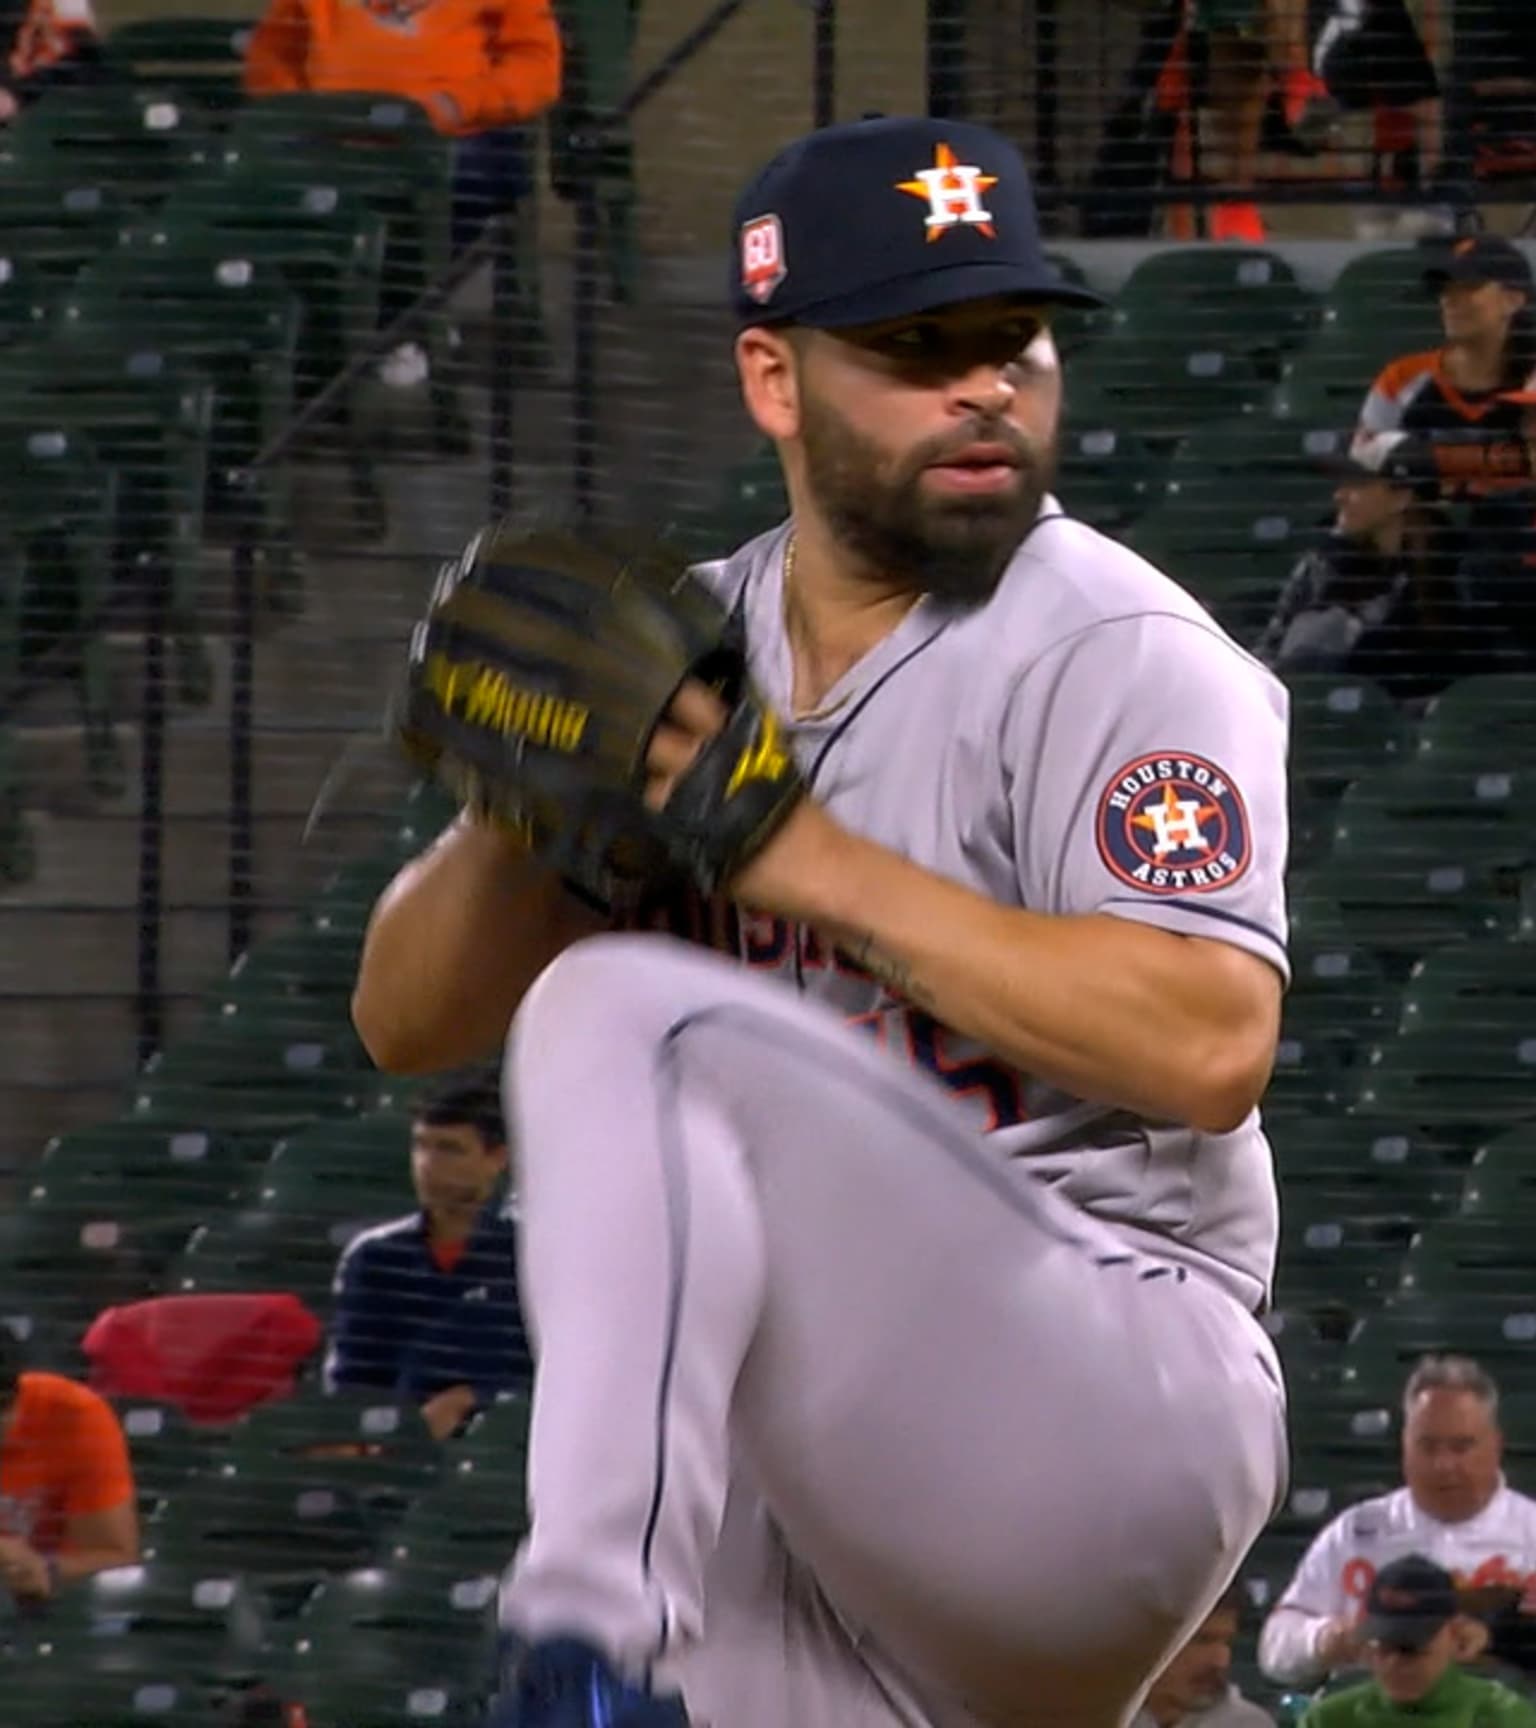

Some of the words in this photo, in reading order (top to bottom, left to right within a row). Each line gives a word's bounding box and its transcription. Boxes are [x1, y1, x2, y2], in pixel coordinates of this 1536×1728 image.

[915, 166, 992, 225] H
[1109, 760, 1227, 809] HOUSTON
[1144, 800, 1209, 855] H
[1133, 852, 1237, 887] ASTROS
